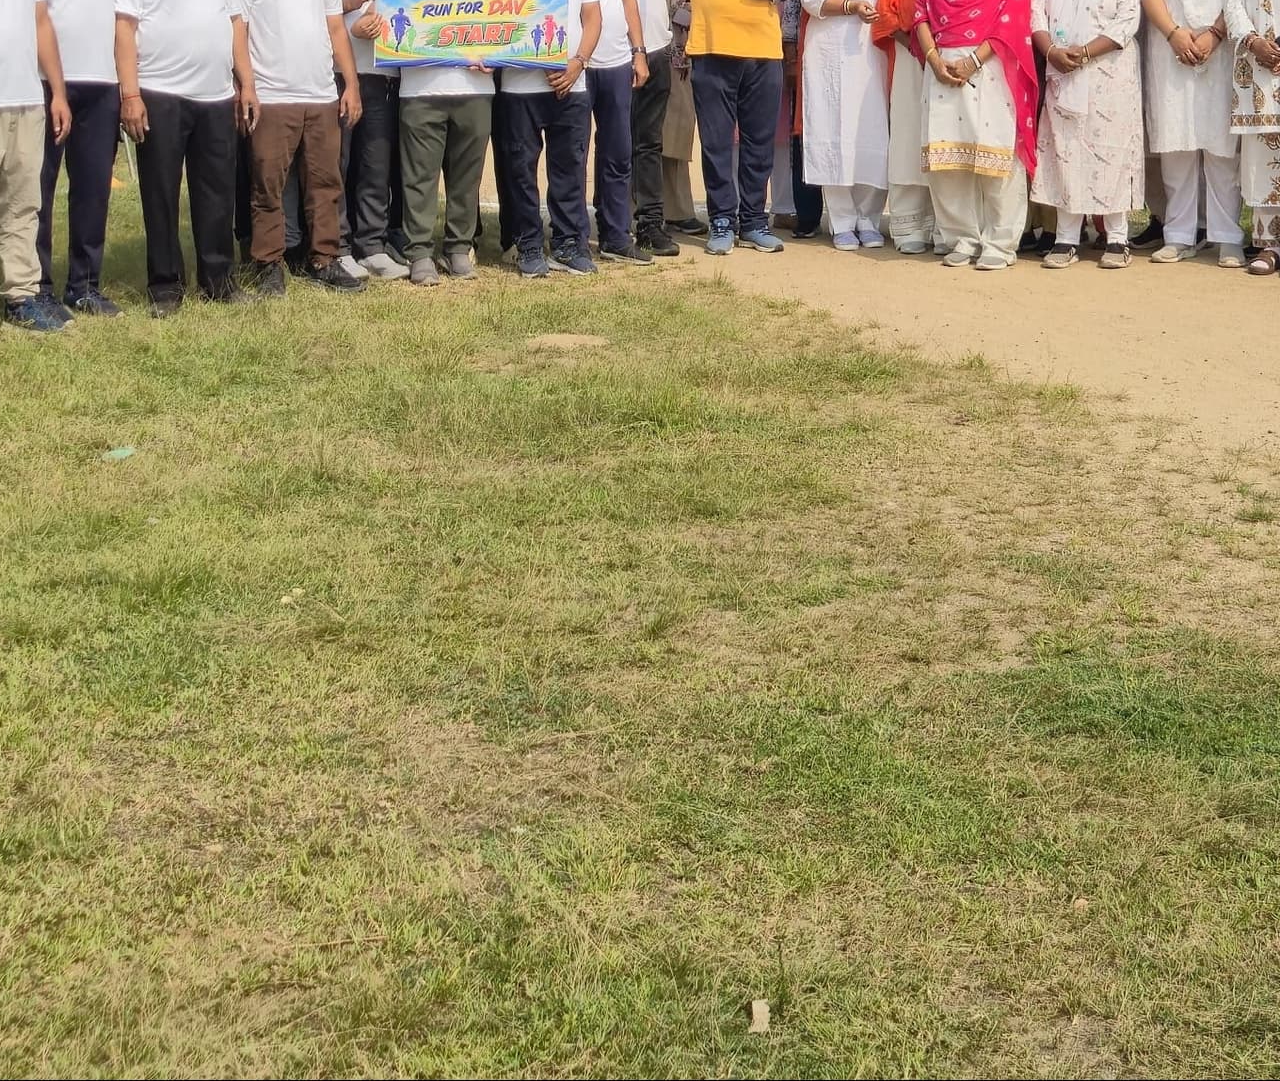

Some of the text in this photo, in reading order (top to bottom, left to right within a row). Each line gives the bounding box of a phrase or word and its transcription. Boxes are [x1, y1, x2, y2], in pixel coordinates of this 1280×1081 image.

[422, 3, 453, 18] RUN
[456, 0, 483, 15] FOR
[438, 22, 518, 47] START
